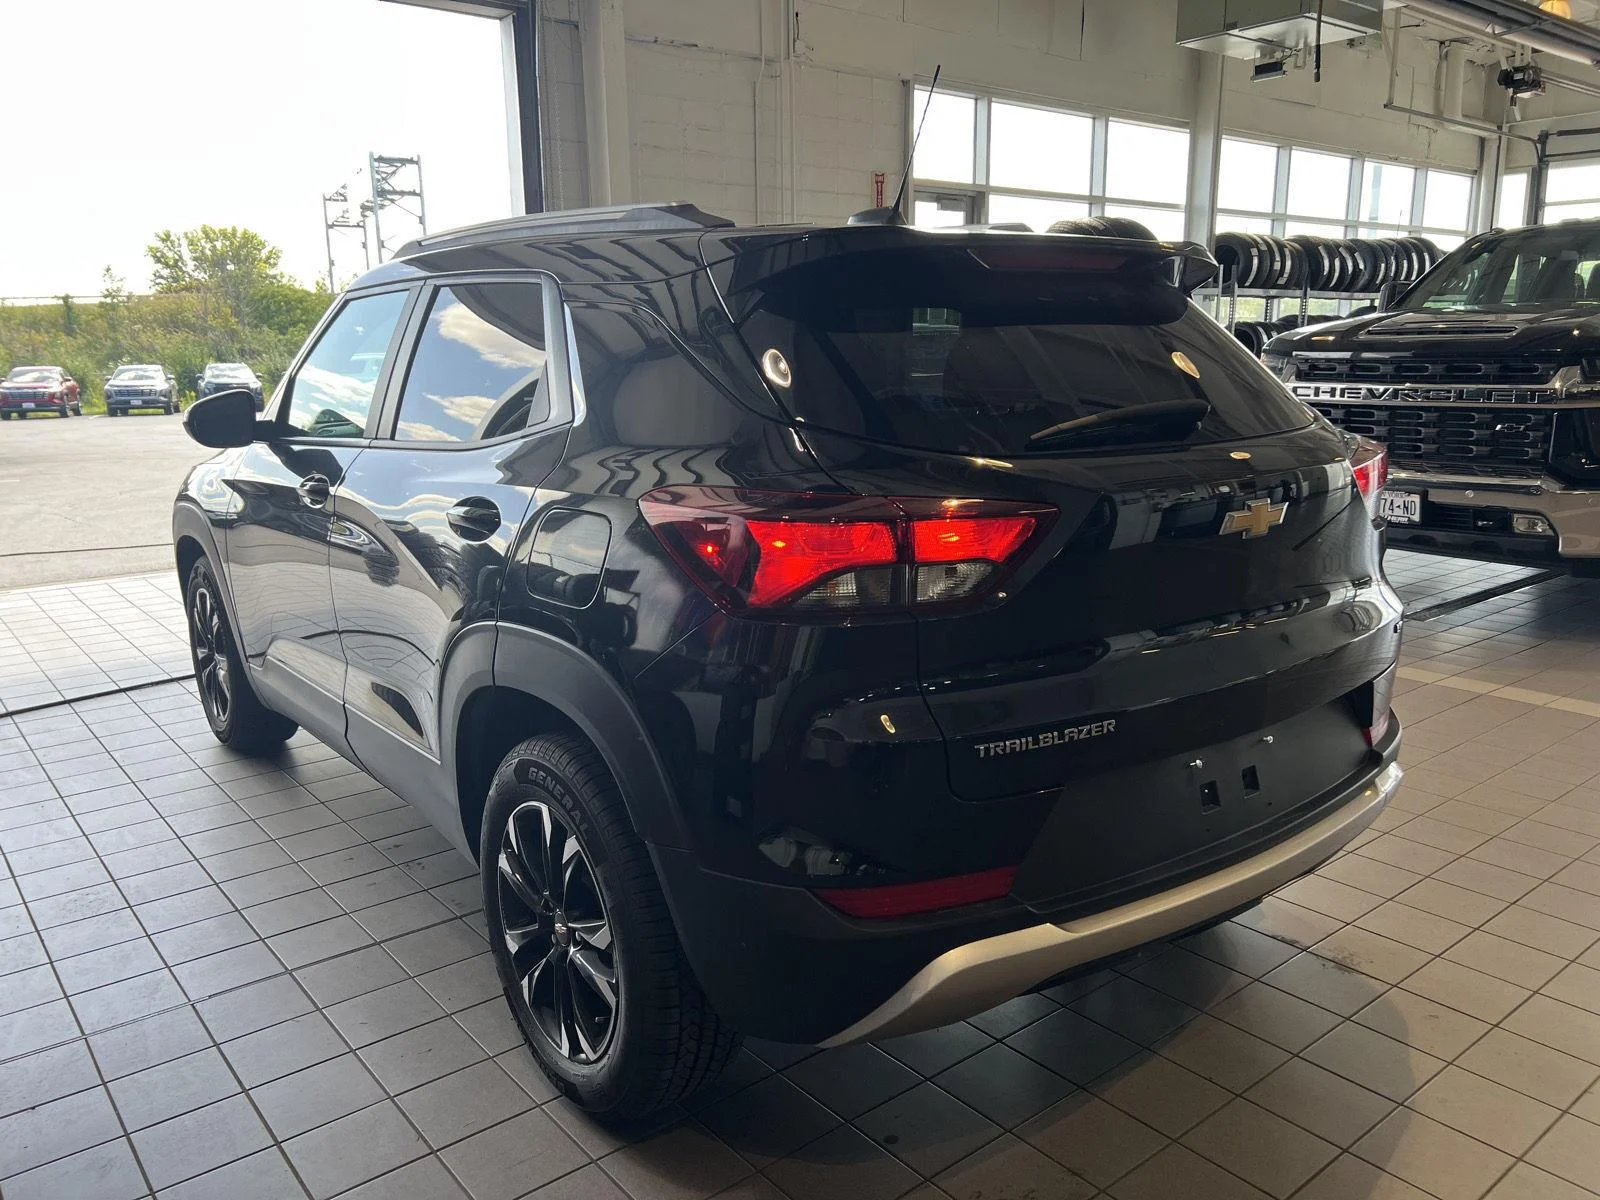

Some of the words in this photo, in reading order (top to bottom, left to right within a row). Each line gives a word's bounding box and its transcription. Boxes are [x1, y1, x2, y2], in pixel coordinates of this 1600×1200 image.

[1292, 385, 1550, 404] CHEVROLET
[974, 719, 1116, 758] TRAILBLAZER
[528, 767, 589, 841] GENERAL
